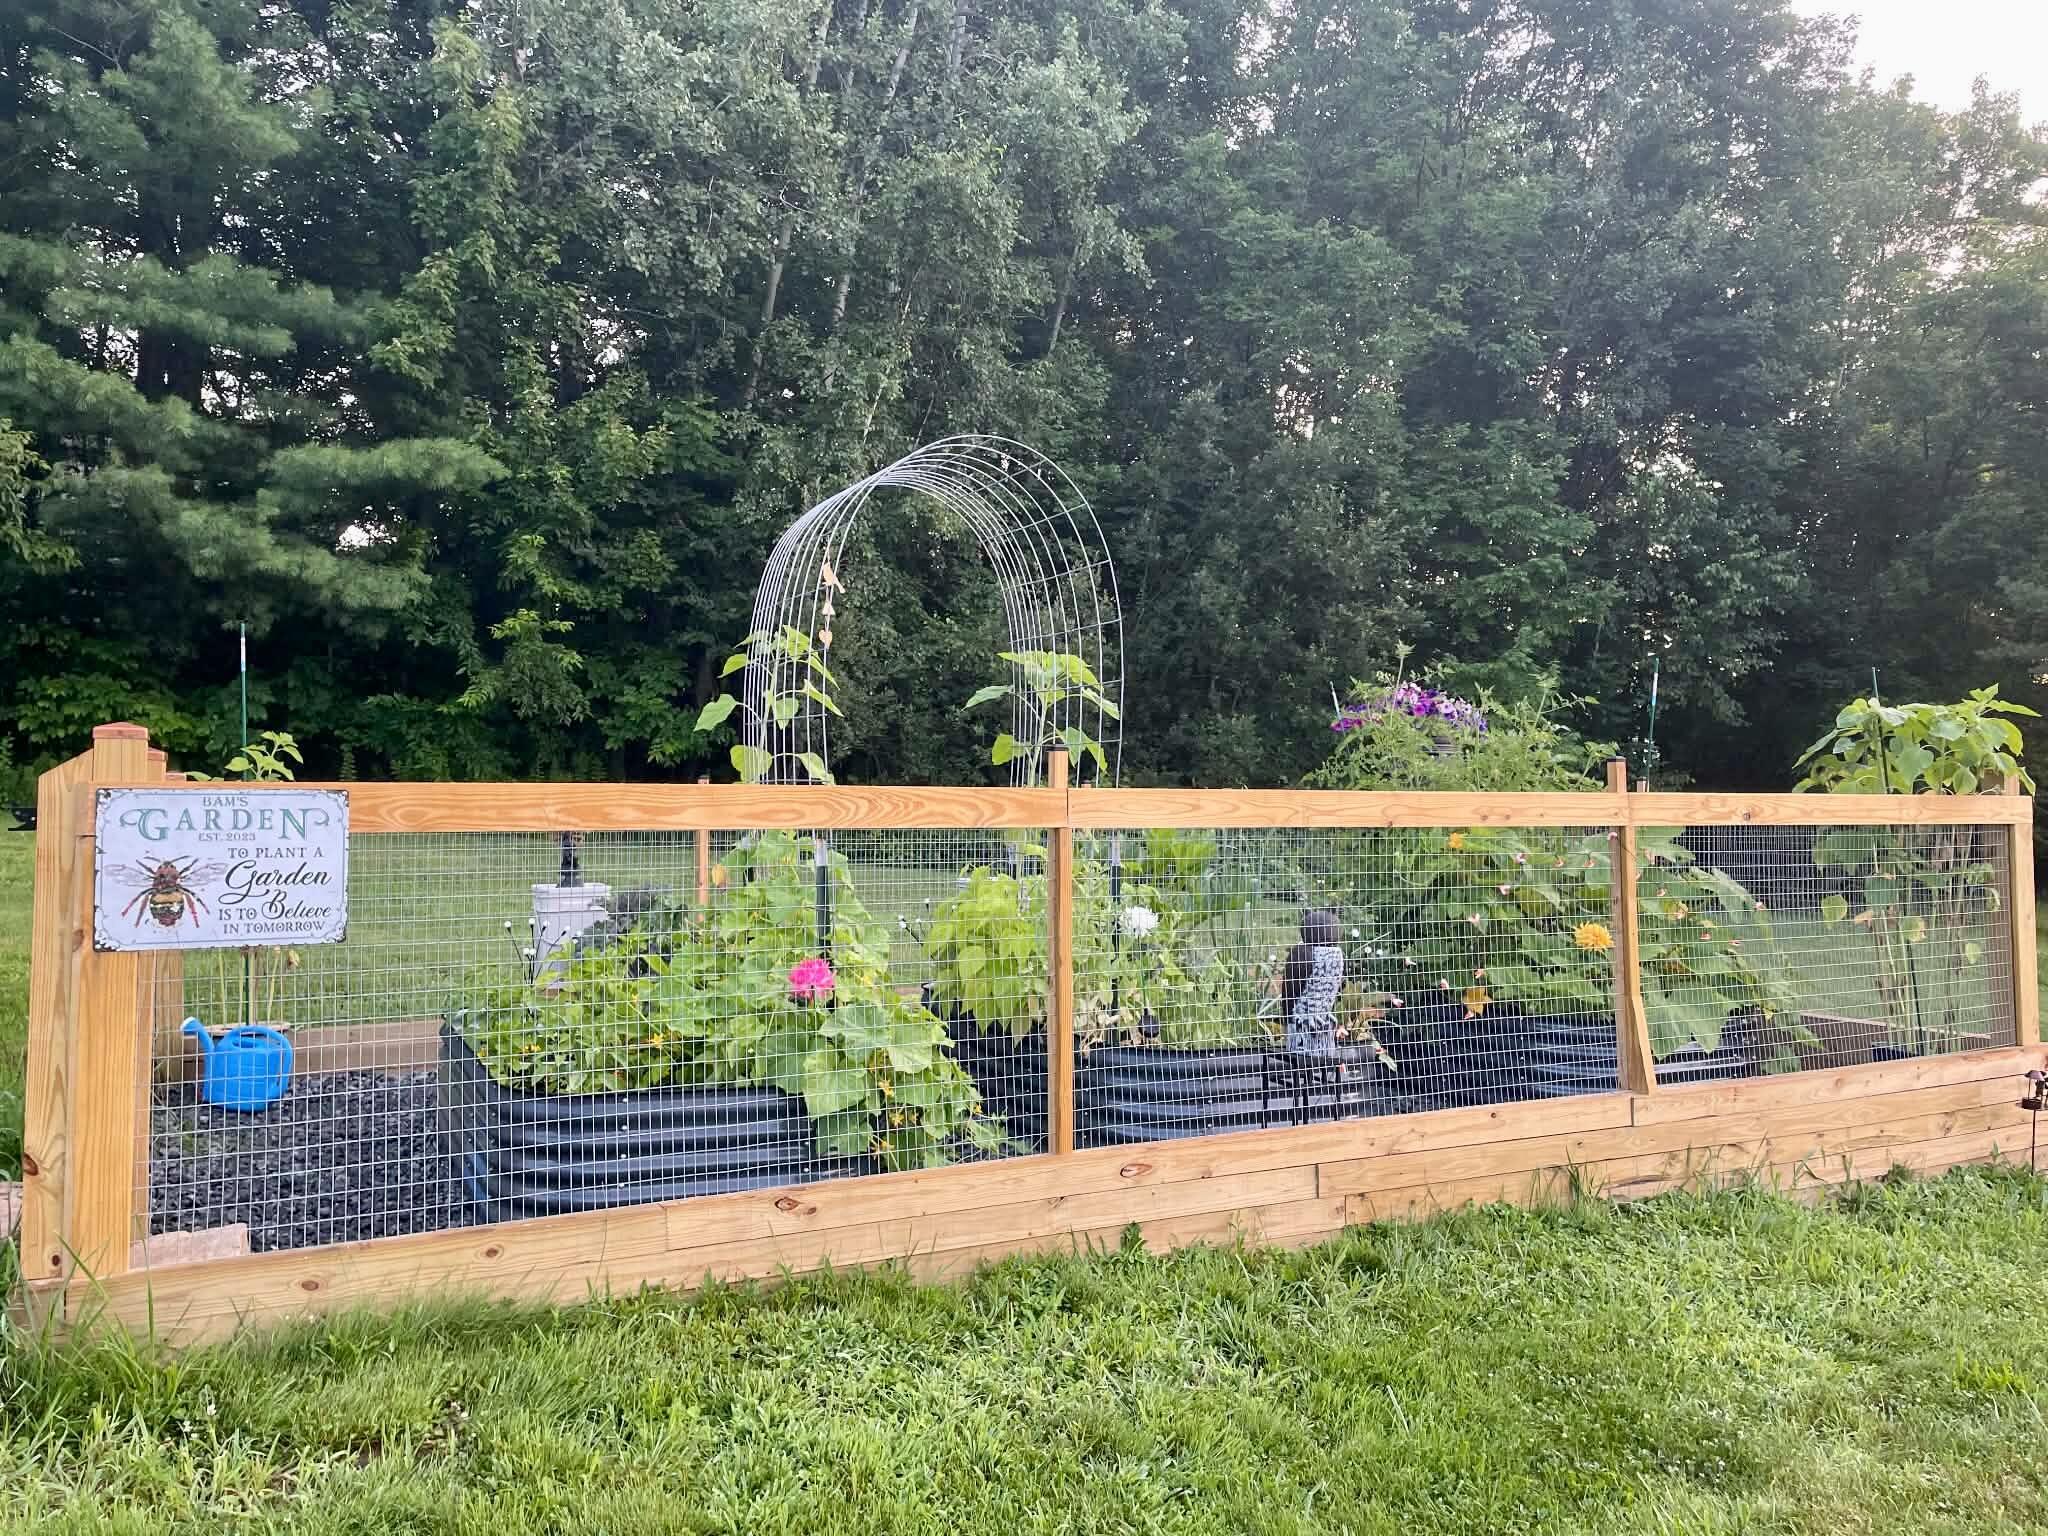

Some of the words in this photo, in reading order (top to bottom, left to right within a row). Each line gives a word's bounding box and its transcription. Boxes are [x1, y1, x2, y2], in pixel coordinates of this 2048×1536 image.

[202, 797, 249, 807] BAM'S
[120, 808, 329, 841] GARDEN
[198, 832, 224, 841] EST.
[226, 832, 256, 841] 2023
[228, 848, 249, 858] TO
[255, 847, 307, 858] PLANT
[313, 846, 325, 858] A
[218, 860, 332, 904] Garden
[219, 909, 232, 920] IS
[237, 908, 257, 920] TO
[262, 889, 331, 919] Believe
[224, 923, 239, 934] IN
[244, 921, 325, 934] TOMORROW
